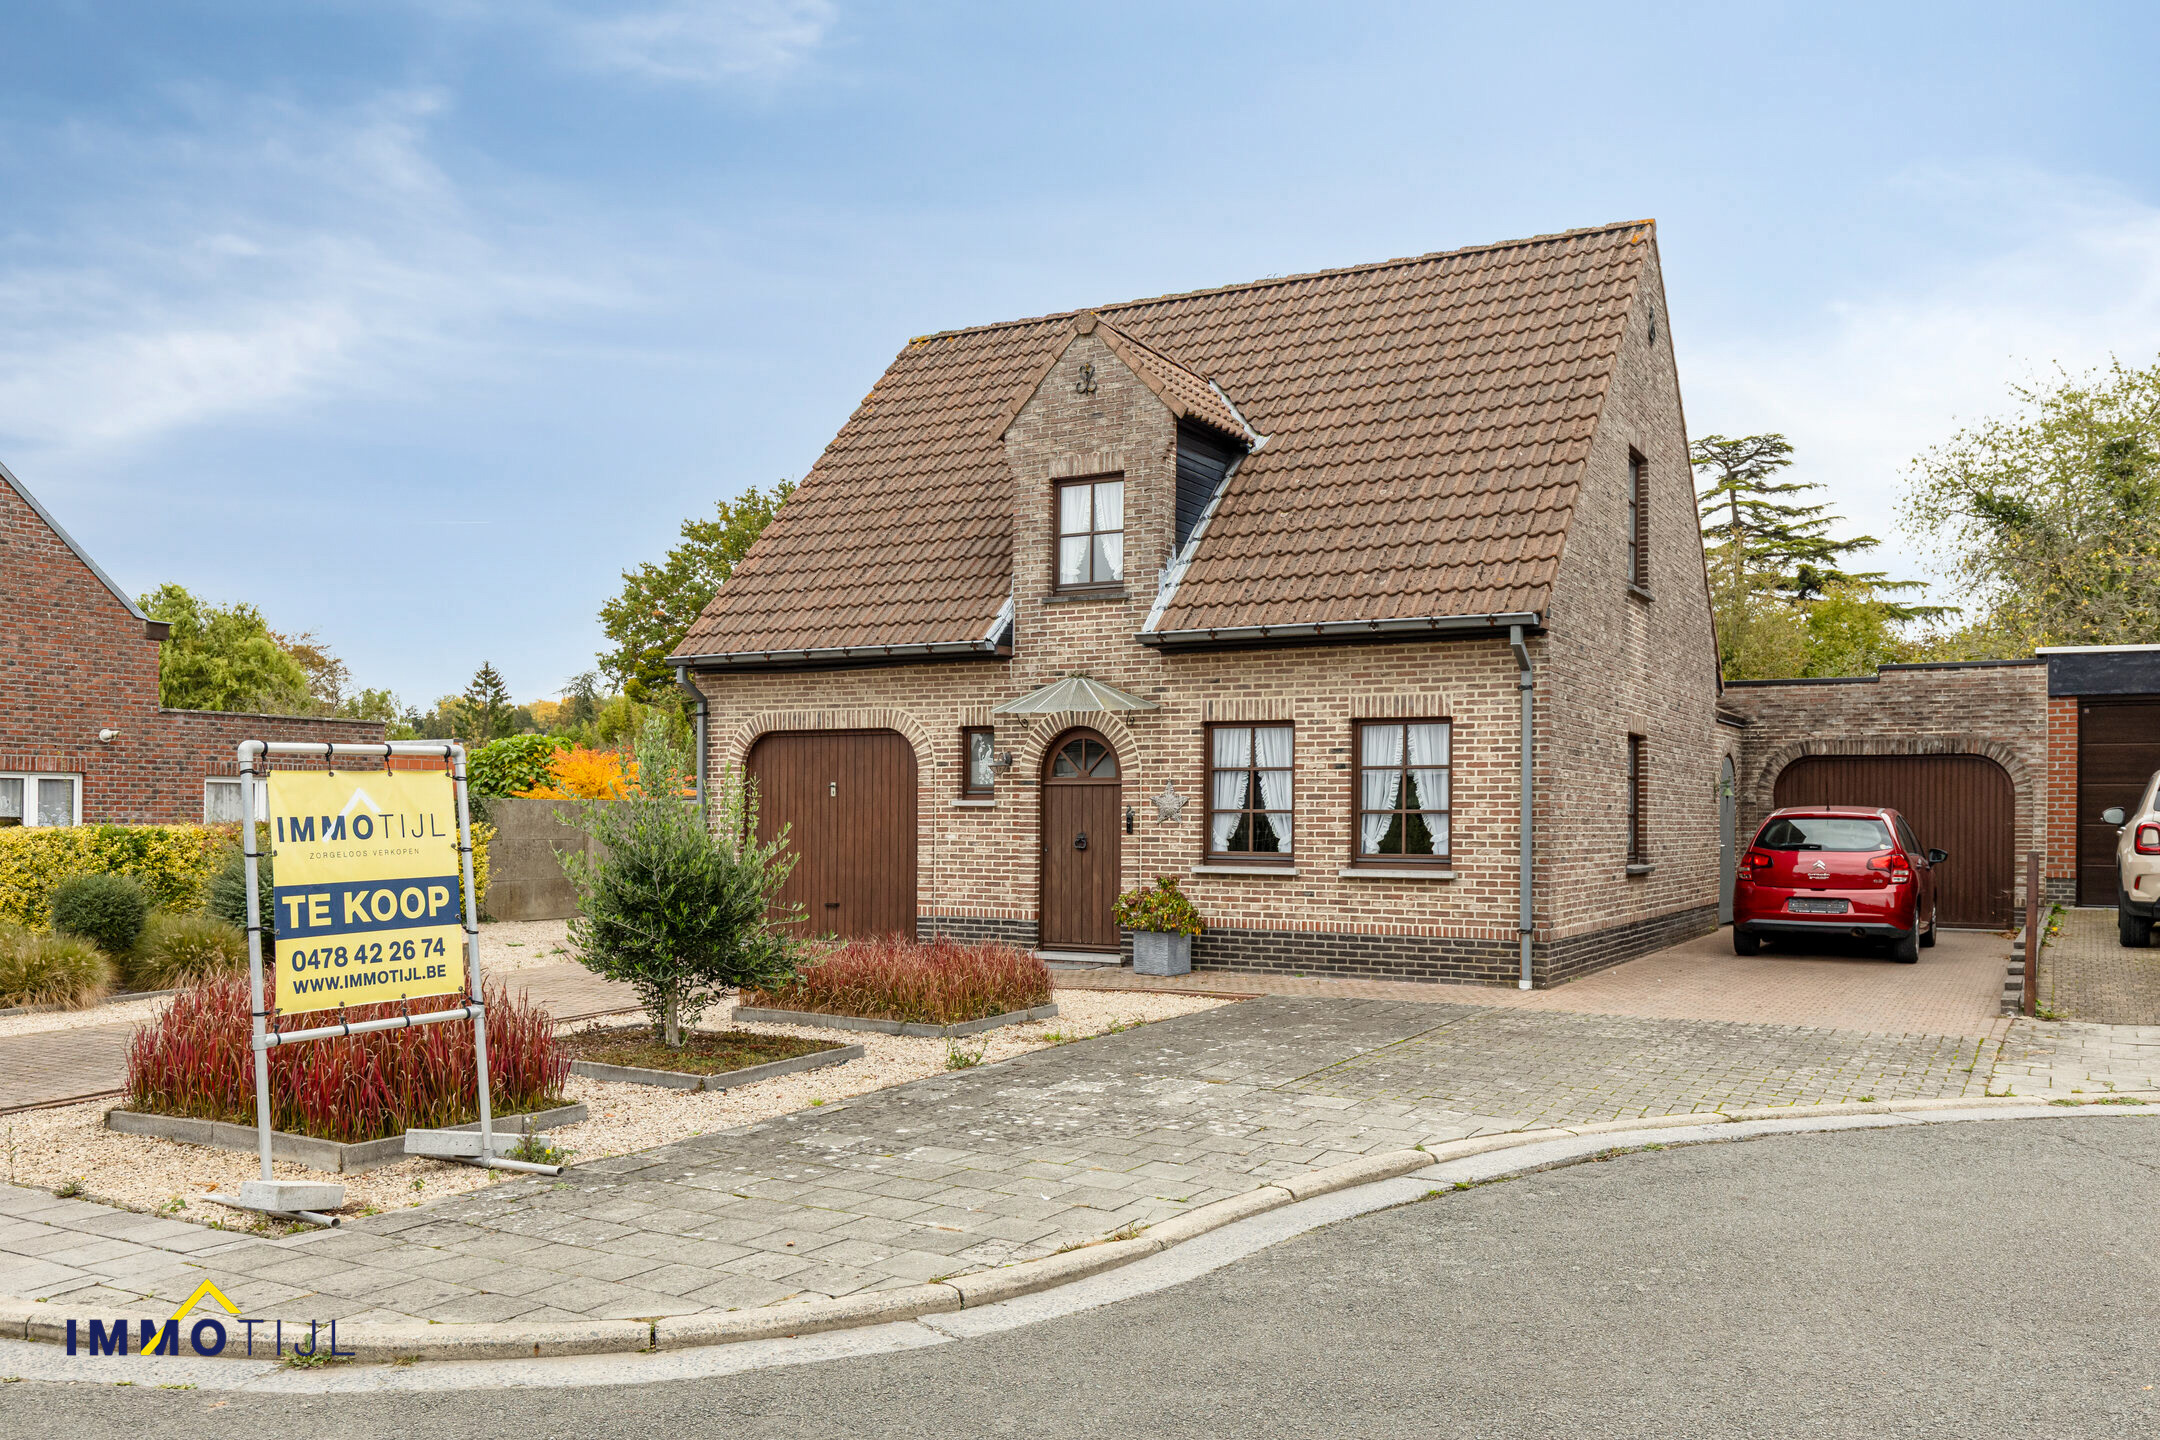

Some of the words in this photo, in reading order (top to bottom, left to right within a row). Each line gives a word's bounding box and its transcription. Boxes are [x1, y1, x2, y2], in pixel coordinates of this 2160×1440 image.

[277, 813, 446, 842] IMMOTIJL
[309, 850, 368, 860] ZORGELOOS
[372, 848, 420, 857] VERKOPEN
[281, 892, 332, 929] TE
[344, 885, 450, 925] KOOP
[291, 946, 348, 972] 0478
[354, 942, 382, 966] 42
[389, 939, 415, 962] 26
[421, 937, 446, 959] 74
[293, 964, 446, 994] WWW.IMMOTIJL.BE
